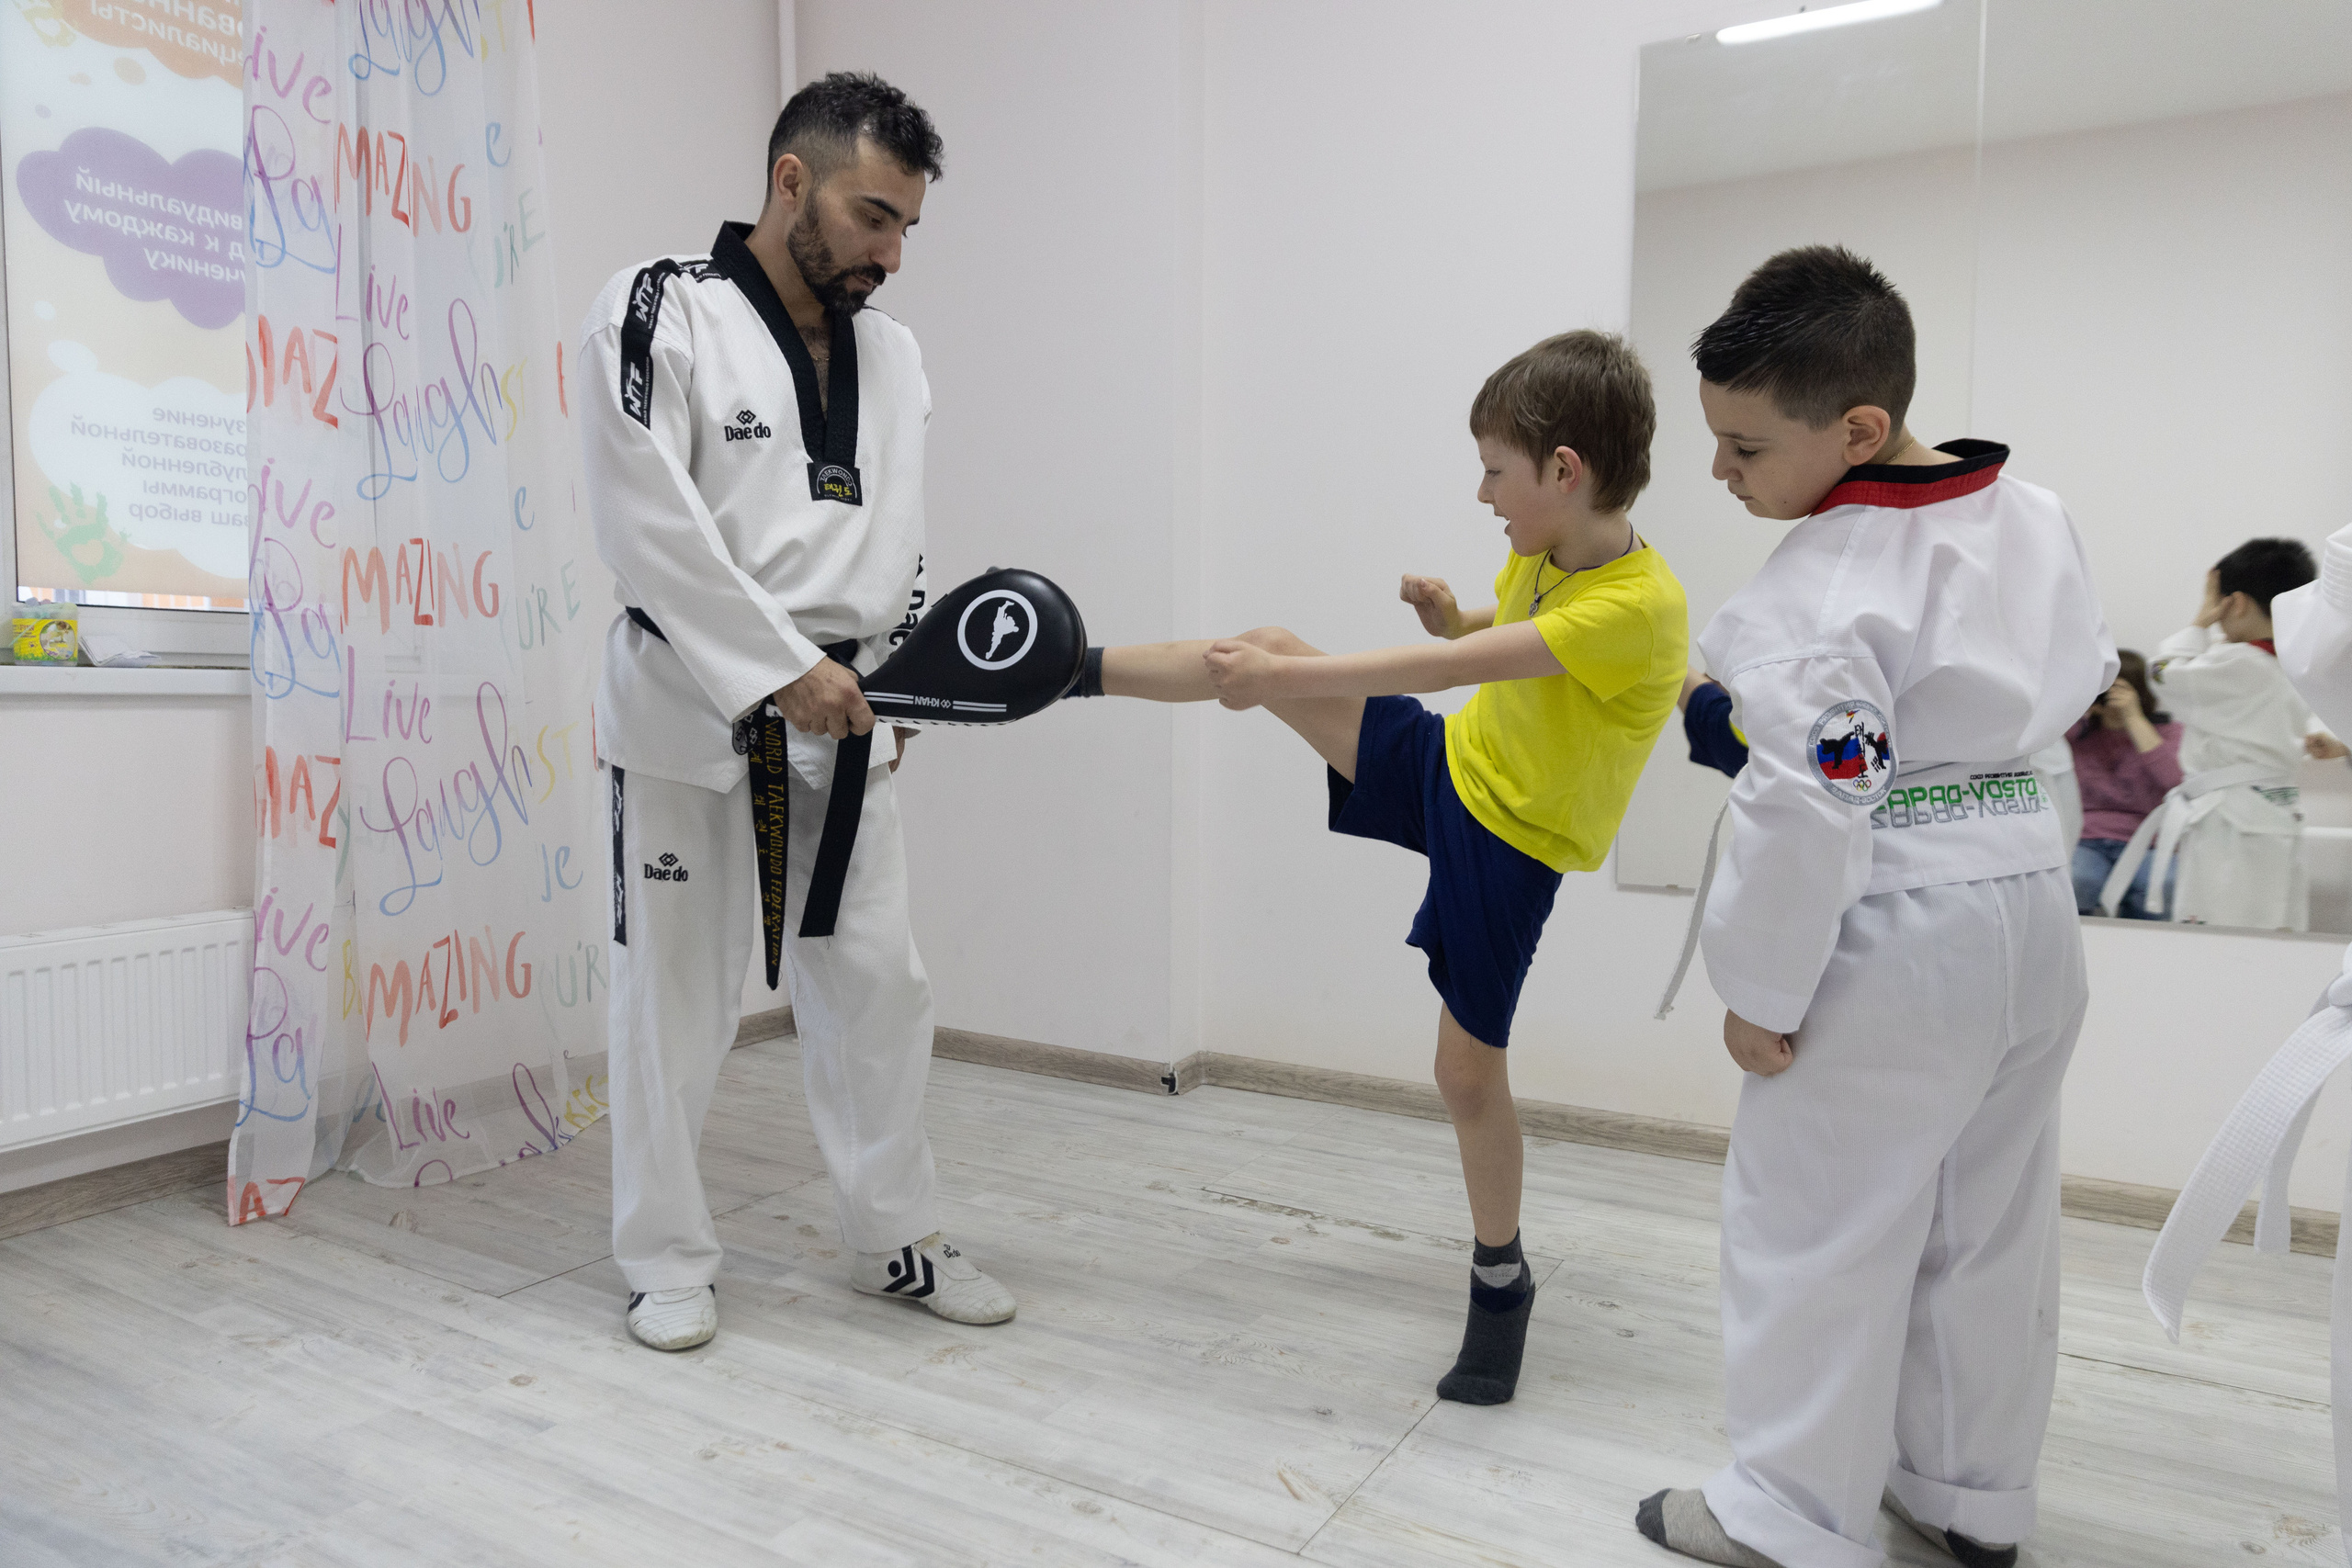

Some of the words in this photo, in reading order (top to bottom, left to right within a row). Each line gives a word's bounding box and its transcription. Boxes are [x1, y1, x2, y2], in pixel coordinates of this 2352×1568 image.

[820, 468, 853, 487] TAEKWONDO
[914, 695, 940, 707] KHAN
[765, 719, 783, 774] WORLD
[1876, 777, 2040, 811] APAD-VOSTO
[768, 784, 785, 875] TAEKWONDO
[771, 878, 783, 966] FEDERATION
